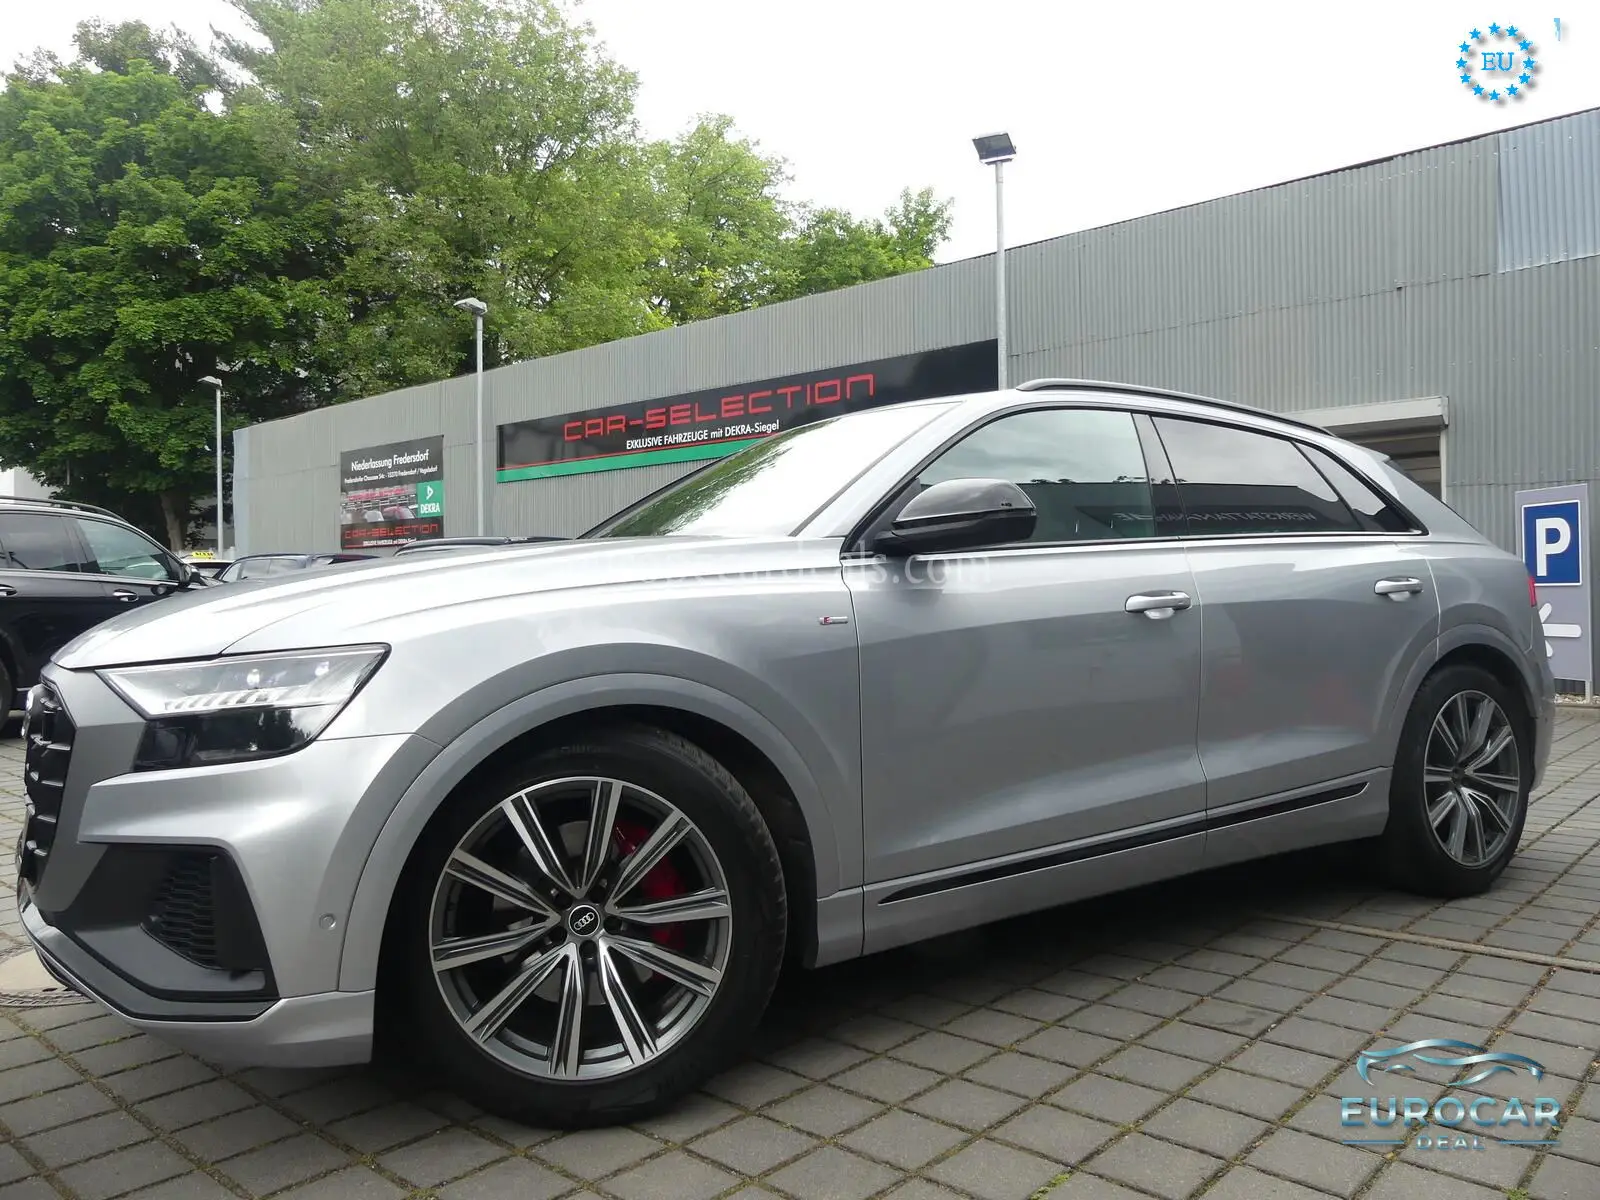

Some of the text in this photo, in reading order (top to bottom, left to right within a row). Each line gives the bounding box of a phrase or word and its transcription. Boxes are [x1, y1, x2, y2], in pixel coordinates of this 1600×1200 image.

[564, 373, 875, 442] CAR-SELECTION
[626, 418, 780, 450] EXKLUSIVE FAHRZEUGE mit DEKRA-Siegel
[351, 449, 429, 472] Niederlassung Fredersdorf
[420, 503, 440, 513] DEKRA
[345, 523, 438, 538] CAR-SELECTION
[1535, 517, 1571, 577] P
